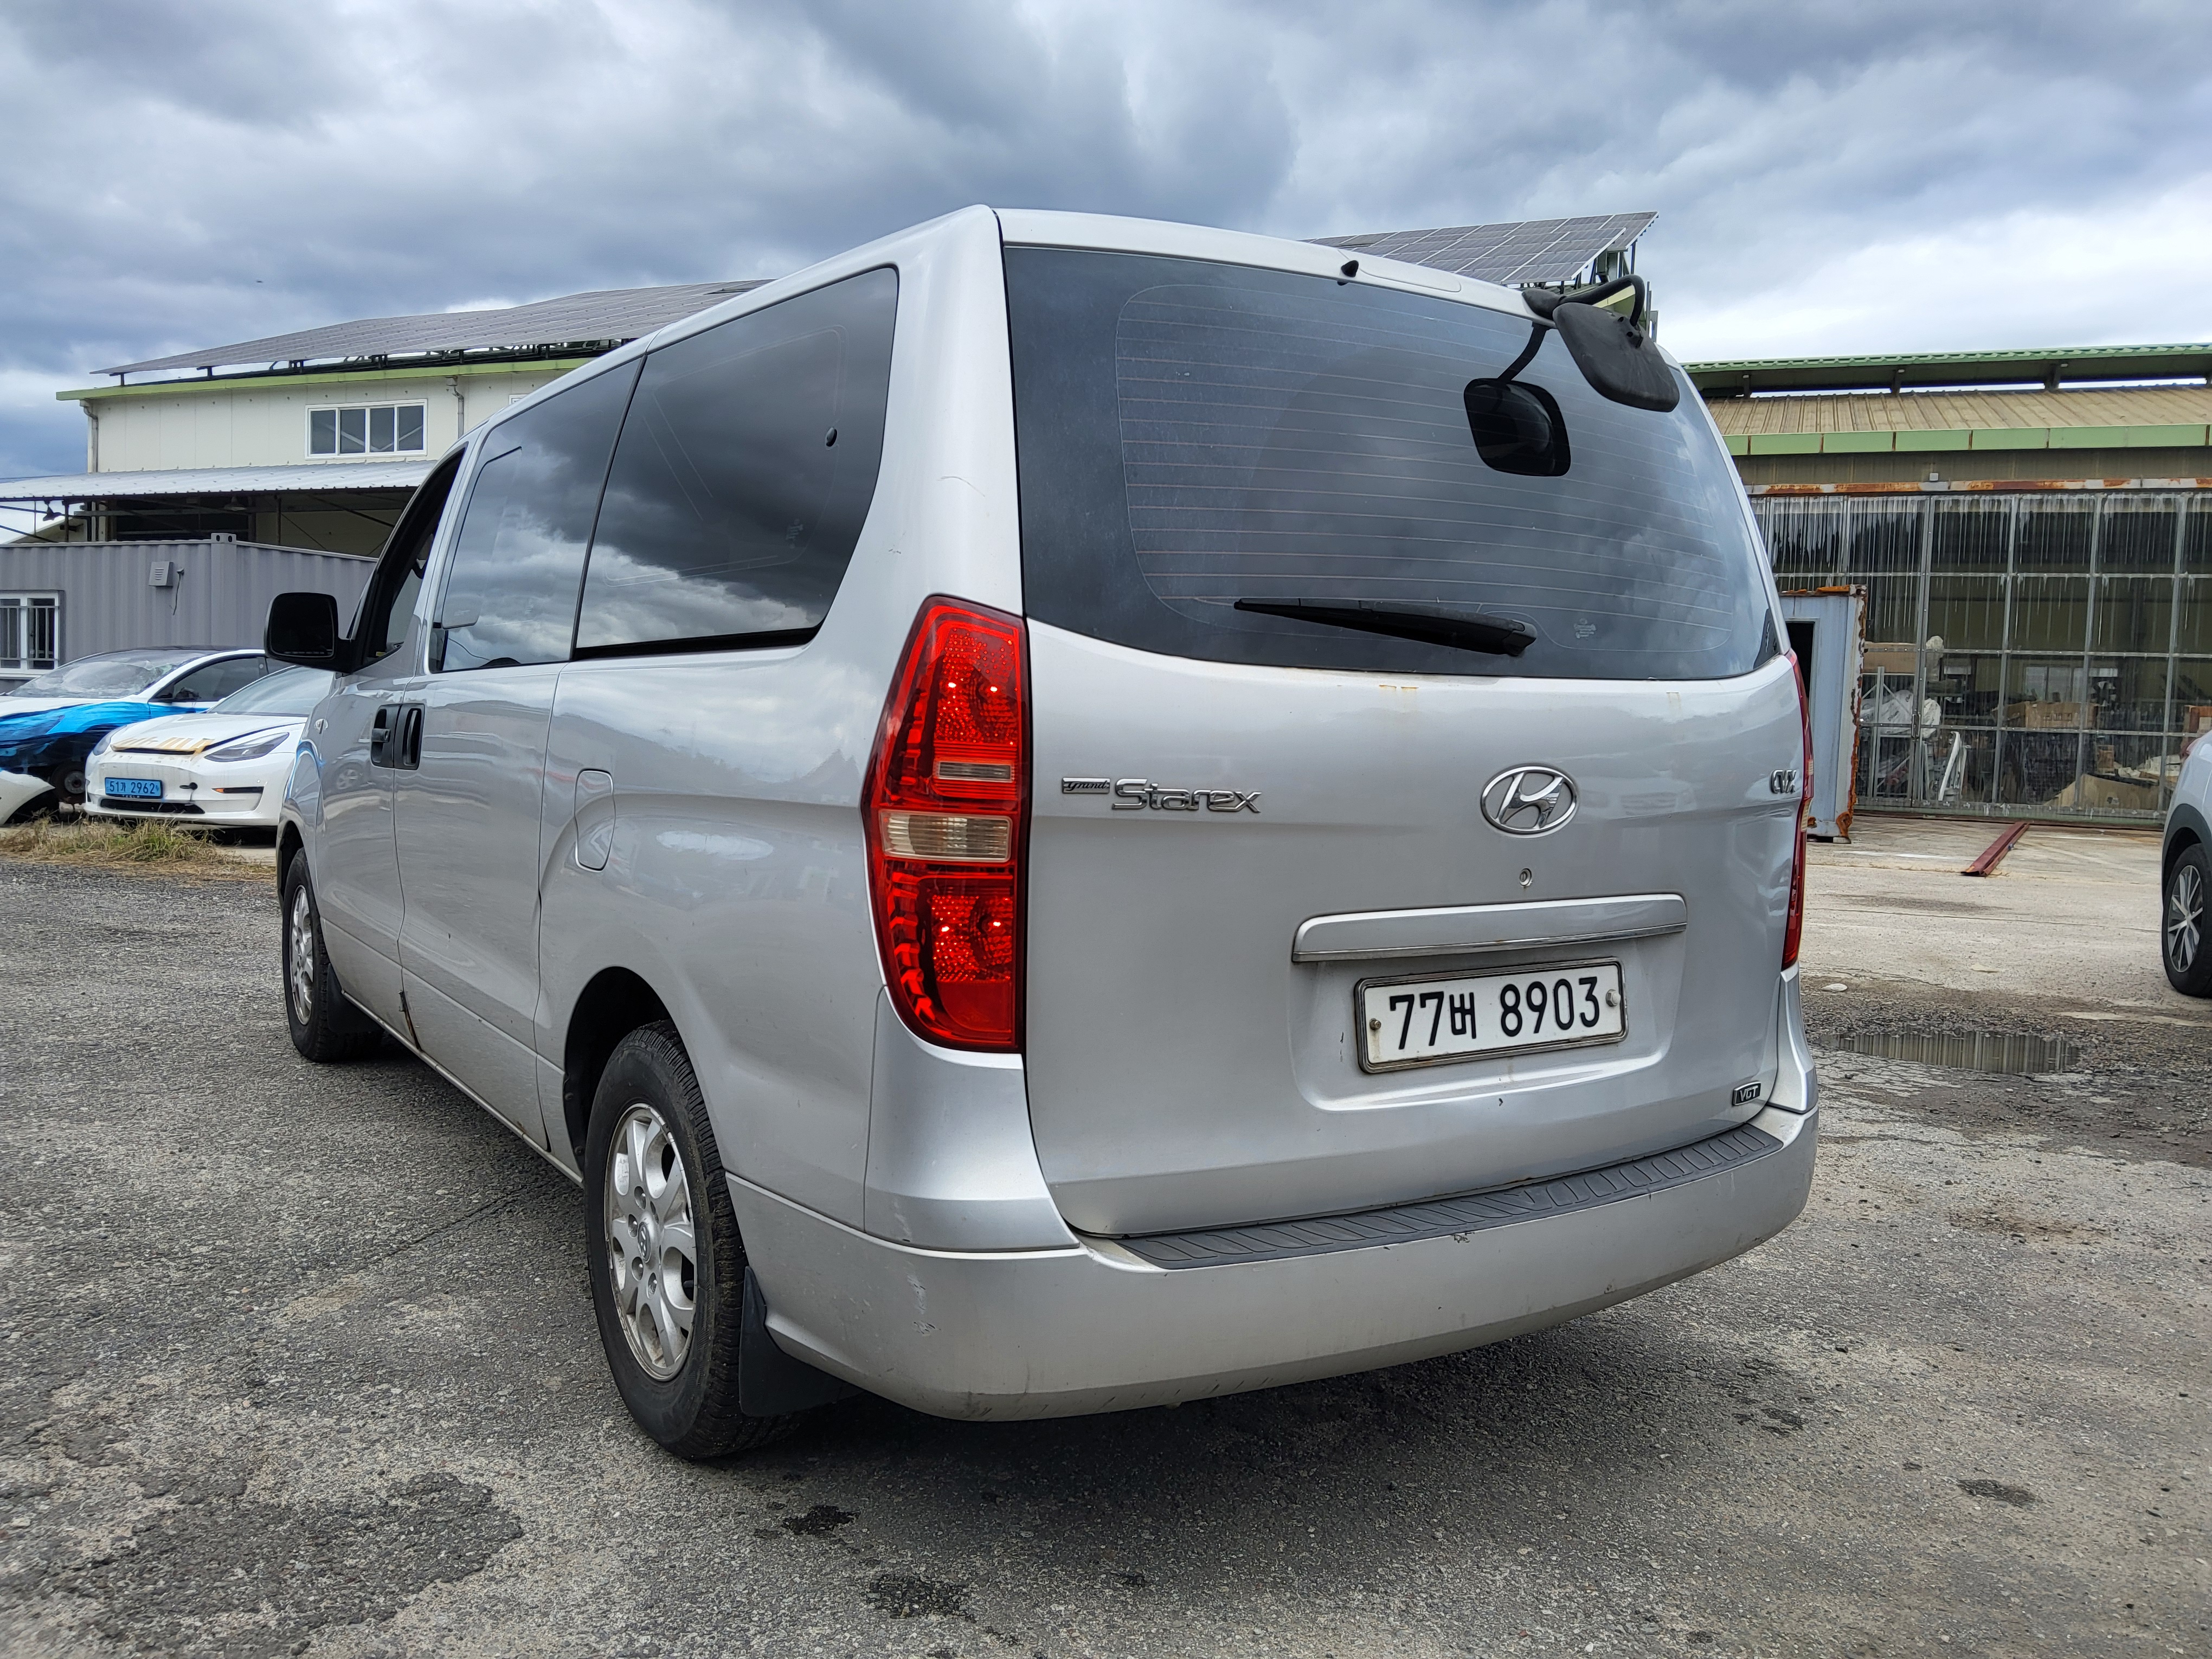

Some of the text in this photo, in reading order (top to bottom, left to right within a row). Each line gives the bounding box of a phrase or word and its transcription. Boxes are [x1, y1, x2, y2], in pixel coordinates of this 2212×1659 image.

[131, 782, 155, 794] 2962
[1112, 778, 1262, 813] Starex
[1390, 976, 1599, 1050] 77버 8903
[1740, 1085, 1758, 1102] VGT
